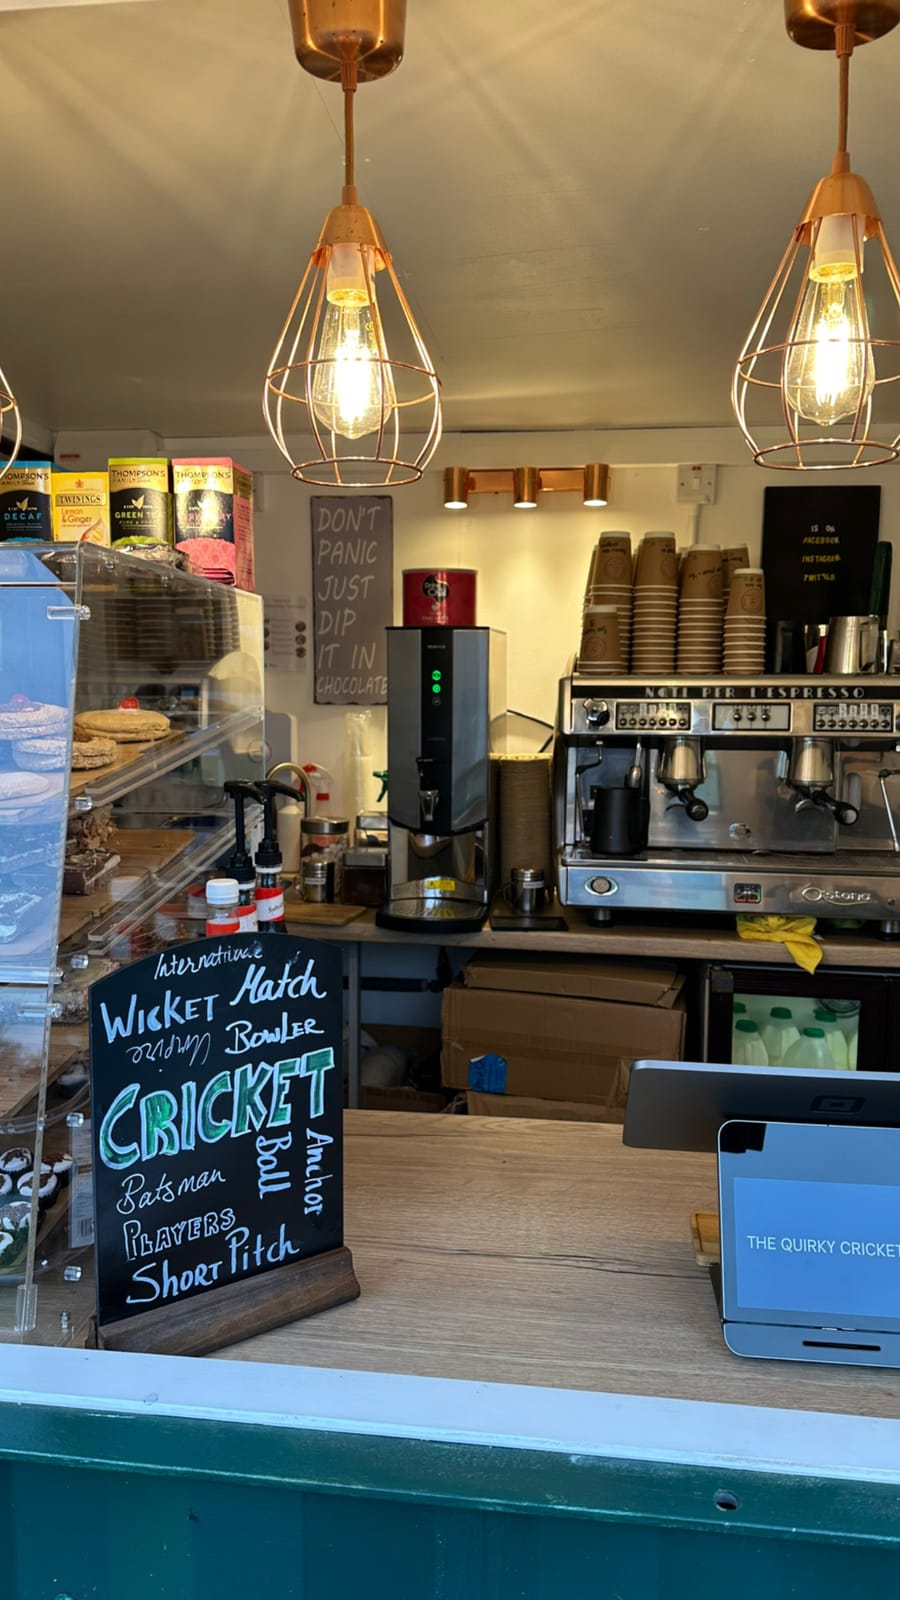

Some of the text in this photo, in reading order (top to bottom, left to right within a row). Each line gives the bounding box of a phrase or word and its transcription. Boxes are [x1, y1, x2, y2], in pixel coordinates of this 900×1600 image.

[60, 494, 102, 505] TWININGS
[60, 507, 83, 516] Lemon
[3, 512, 43, 521] DECAF
[114, 511, 144, 519] GREEN
[317, 505, 381, 533] DON'T
[317, 538, 378, 566] PANIC
[317, 574, 375, 601] JUST
[317, 607, 357, 637] DIP
[318, 642, 376, 670] IT IN
[316, 675, 389, 695] CHOCOLATE
[702, 687, 736, 698] PER
[750, 686, 865, 698] L'ESPRESSO
[229, 957, 328, 1007] Match
[99, 1046, 336, 1171] CRICKET
[255, 1131, 293, 1201] Ball
[303, 1127, 334, 1216] Anchor
[115, 1168, 227, 1215] Batsman
[122, 1207, 236, 1262] PLAYERS
[746, 1234, 777, 1250] THE
[780, 1237, 836, 1254] QUIRKY
[224, 1223, 300, 1275] Pitch
